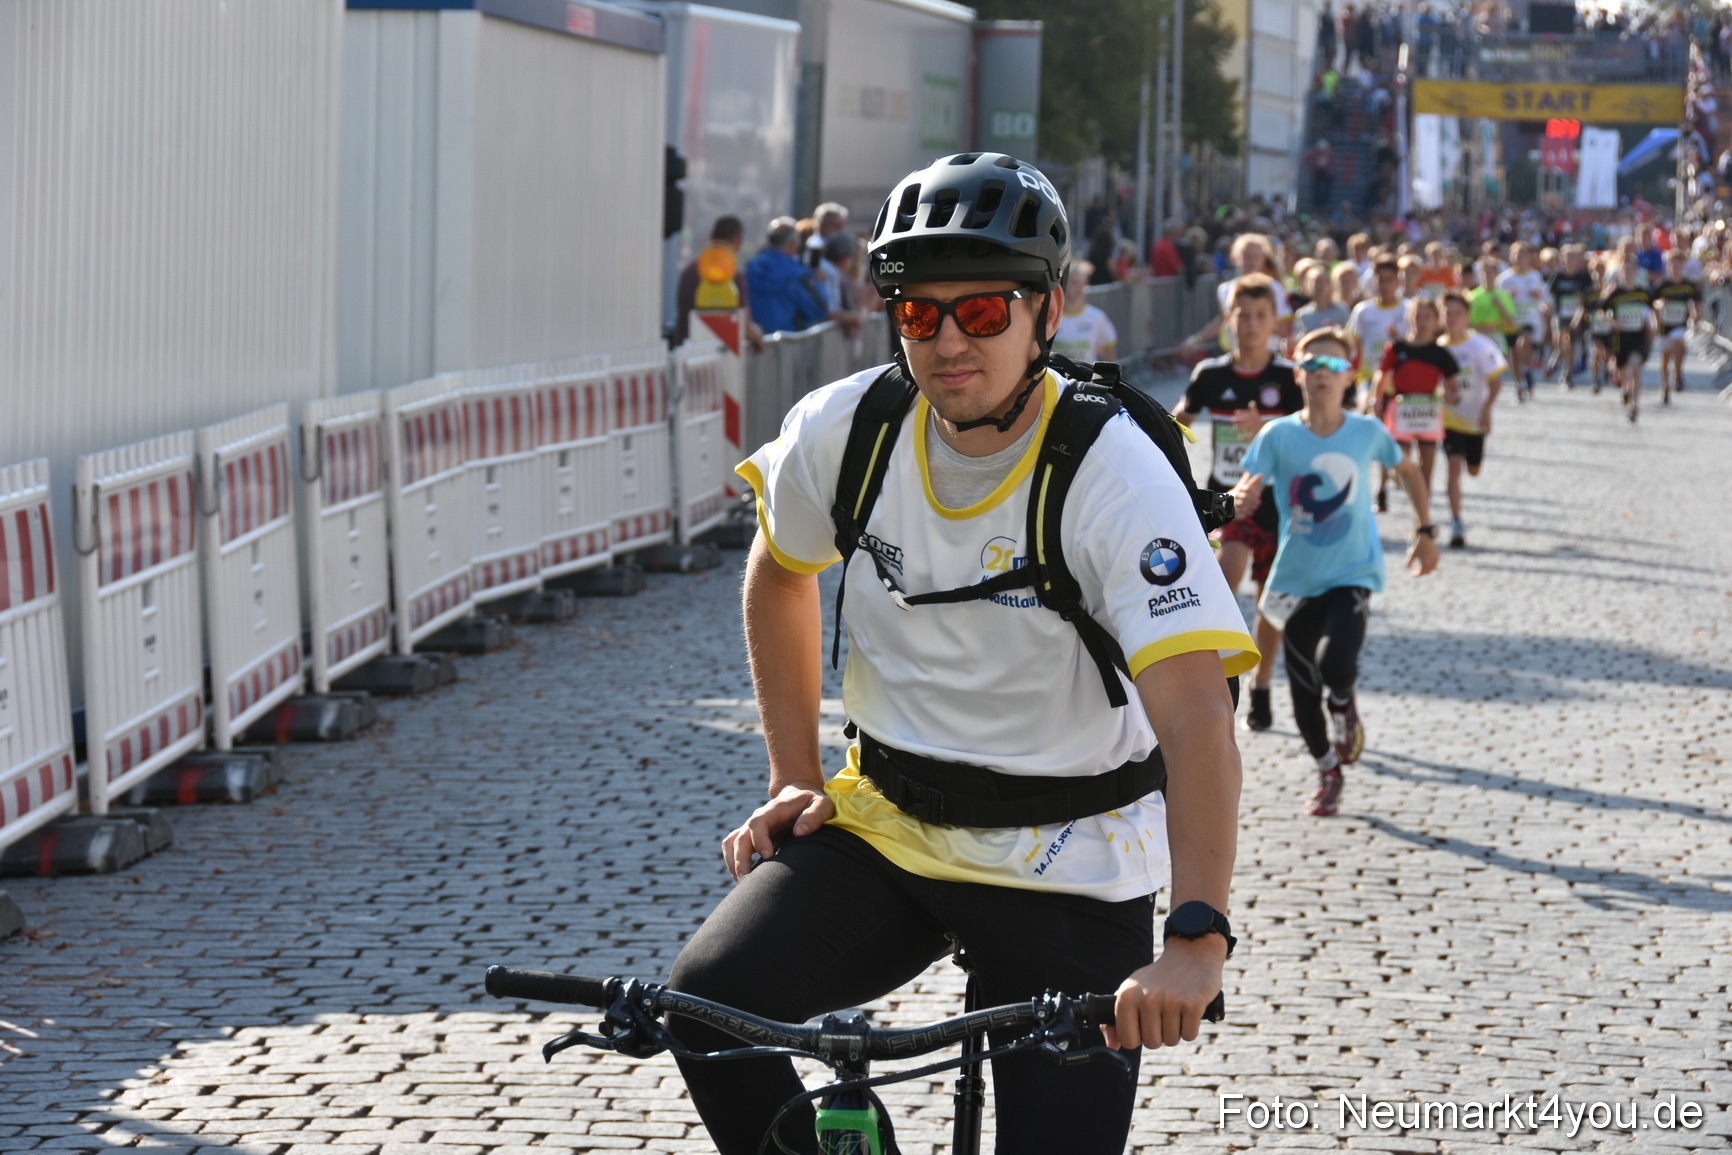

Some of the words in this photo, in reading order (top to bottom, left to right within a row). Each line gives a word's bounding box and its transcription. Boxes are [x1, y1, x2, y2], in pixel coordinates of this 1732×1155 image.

[1501, 88, 1592, 113] START
[1141, 540, 1179, 561] BMW
[980, 589, 1043, 609] adtlauf
[1148, 586, 1199, 612] PARTL
[1150, 598, 1202, 619] Neumarkt
[673, 998, 804, 1049] RACEFACE
[888, 1011, 1018, 1053] ATLAS
